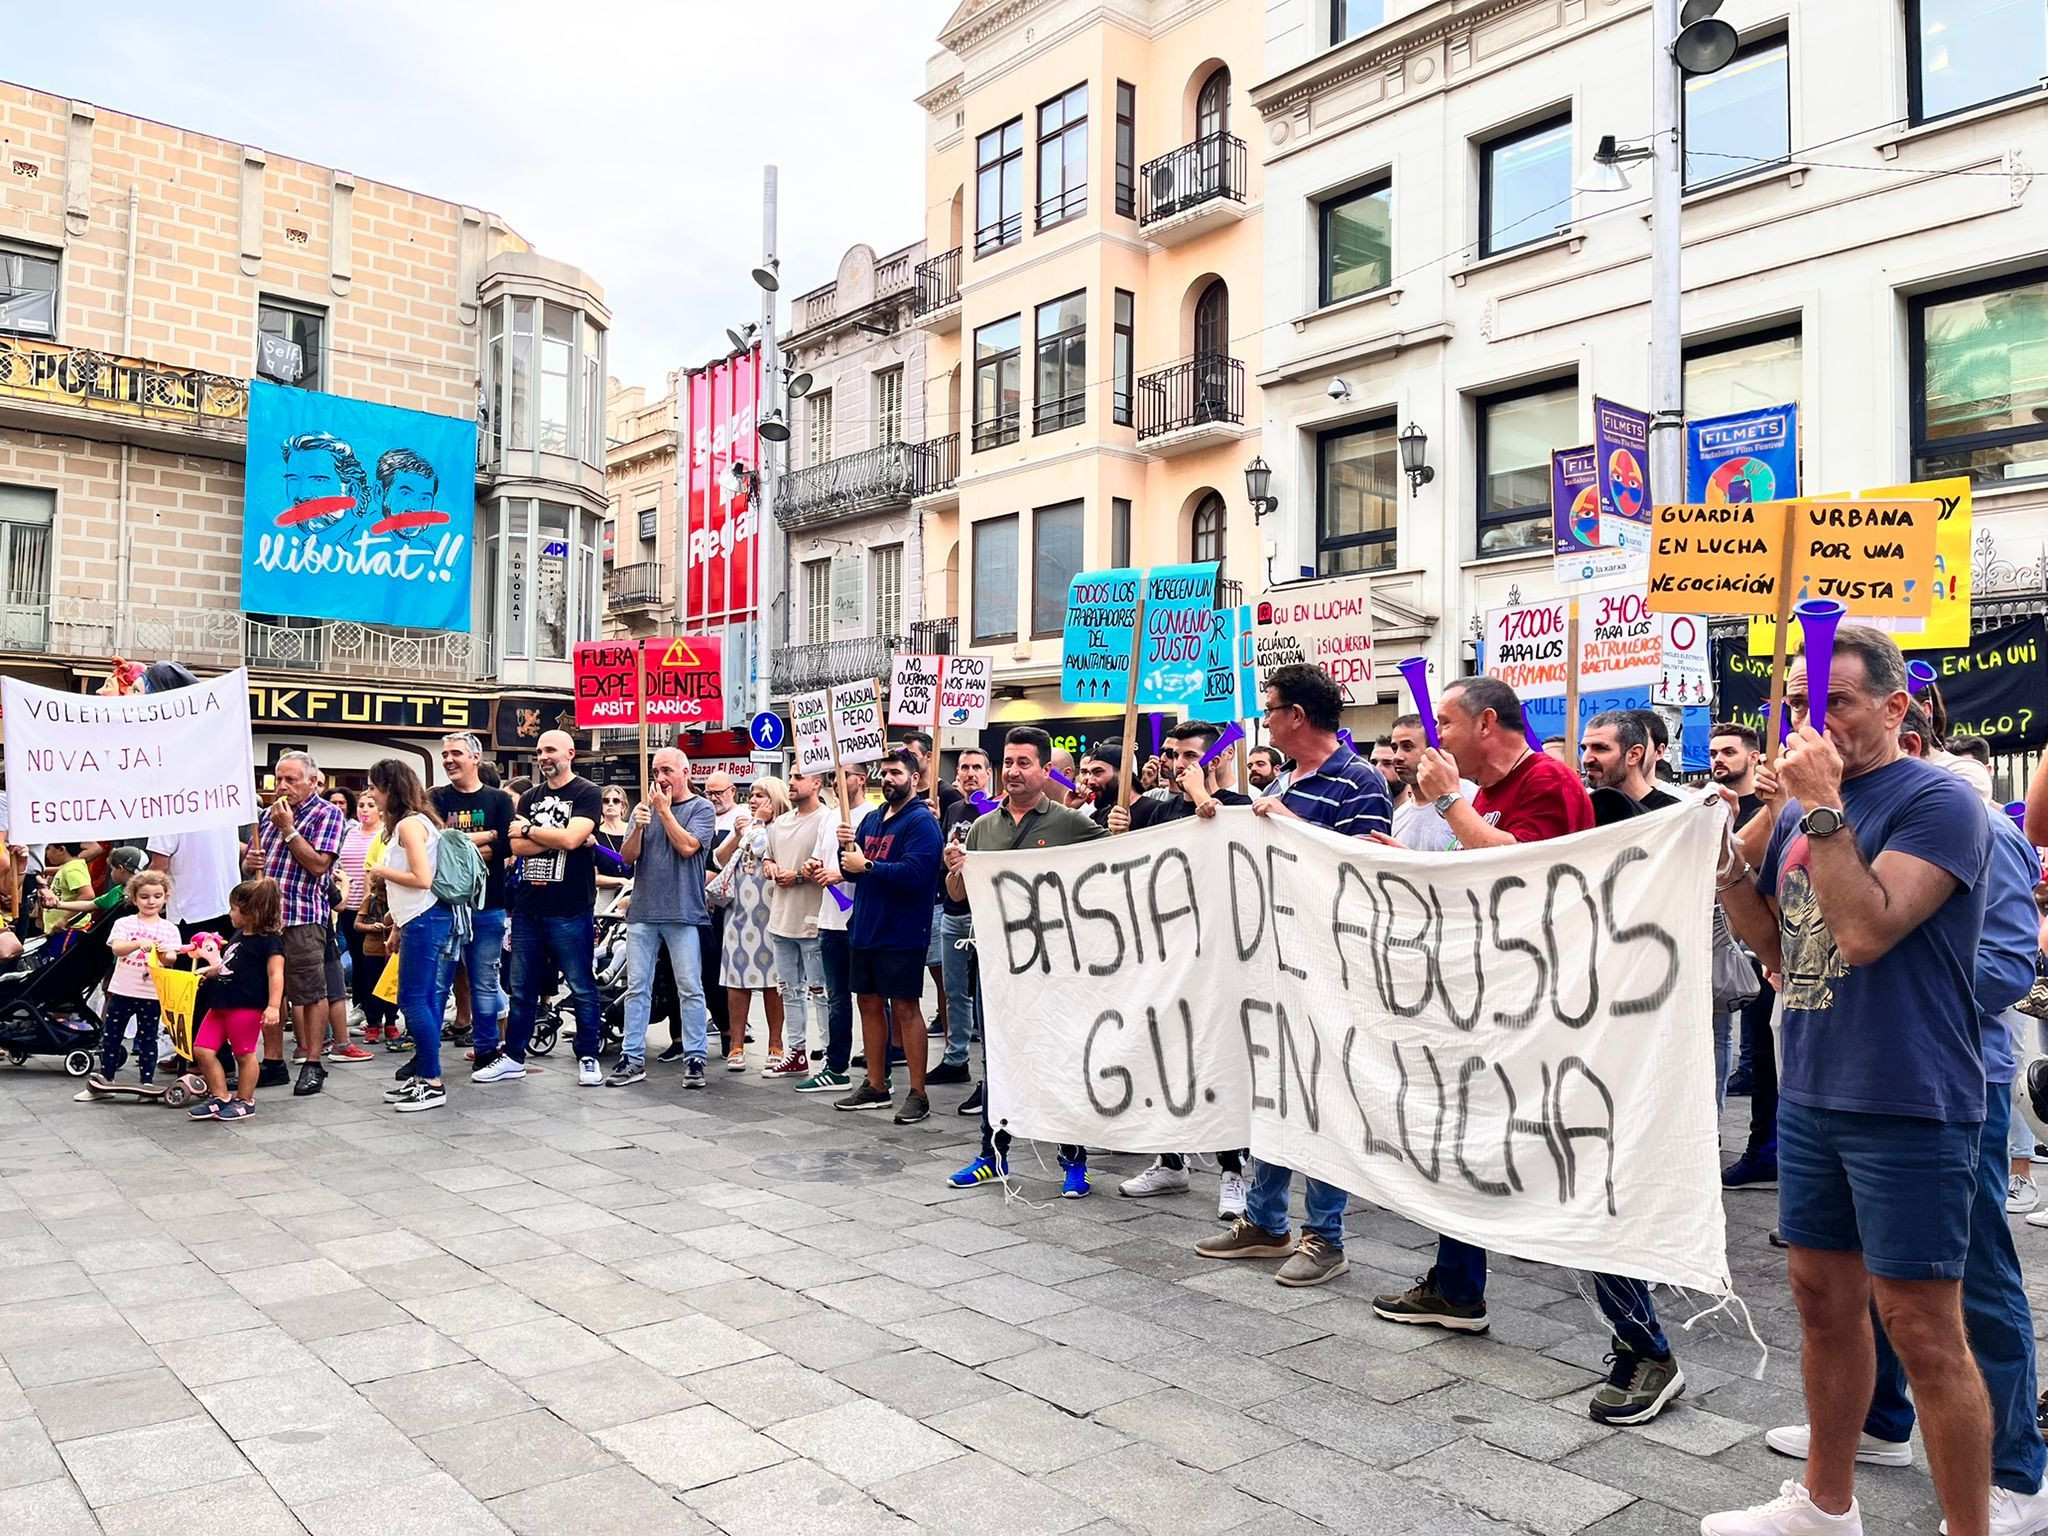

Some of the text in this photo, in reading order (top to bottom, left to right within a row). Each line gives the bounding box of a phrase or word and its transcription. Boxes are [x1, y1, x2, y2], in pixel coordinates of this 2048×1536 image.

[695, 403, 751, 467] Baza
[1604, 416, 1643, 437] FILMETS
[1705, 422, 1779, 445] FILMETS
[1736, 445, 1754, 455] Film
[1755, 439, 1785, 451] Festival
[1569, 458, 1596, 472] FIL
[1810, 509, 1914, 527] URBANA
[543, 541, 568, 558] API
[1658, 538, 1688, 554] EN
[1697, 538, 1767, 554] LUCHA
[1810, 540, 1851, 559] POR
[1864, 542, 1905, 559] UNA
[513, 552, 521, 621] ADVOCAT
[1073, 581, 1136, 604] TODOS LOS
[1150, 578, 1212, 600] MERECEN UN
[1651, 572, 1775, 594] NEGOCIACIÓN
[1069, 607, 1136, 628] TRABAJADORES
[1149, 604, 1213, 636] CONVENIO
[1273, 597, 1362, 625] GU EN LUCHA!
[1088, 630, 1109, 648] DEL
[1594, 621, 1651, 641] PARA LOS
[581, 647, 635, 667] FUERA
[1150, 635, 1201, 663] JUSTO
[1499, 640, 1563, 663] PARA LOS
[1584, 634, 1663, 660] PATRULLEROS
[1942, 638, 2037, 675] EN LA UVI
[951, 659, 984, 675] PERO
[1066, 649, 1130, 671] AYUNTAMIENTO
[1428, 663, 1435, 673] 2
[904, 686, 929, 699] ESTAR
[945, 677, 986, 690] NOS HAN
[24, 697, 111, 723] VOLEM
[121, 691, 221, 723] L'ESCOLA
[835, 687, 878, 709] MENSUAL
[898, 698, 931, 715] AQUÍ
[942, 692, 985, 708] OBLIGADO
[801, 716, 828, 735] QUIEN
[842, 708, 874, 726] PERO
[1953, 708, 2033, 738] ALGO?
[838, 728, 886, 754] TRABAJA?
[28, 749, 100, 772] NOVA
[804, 746, 830, 765] GANA
[691, 764, 715, 775] Bazar
[120, 787, 199, 819] VENTÓS
[205, 784, 241, 810] MIR
[991, 841, 1679, 1031] BASTA DE ABUSOS
[1084, 997, 1617, 1216] G.U. EN LUCHA
